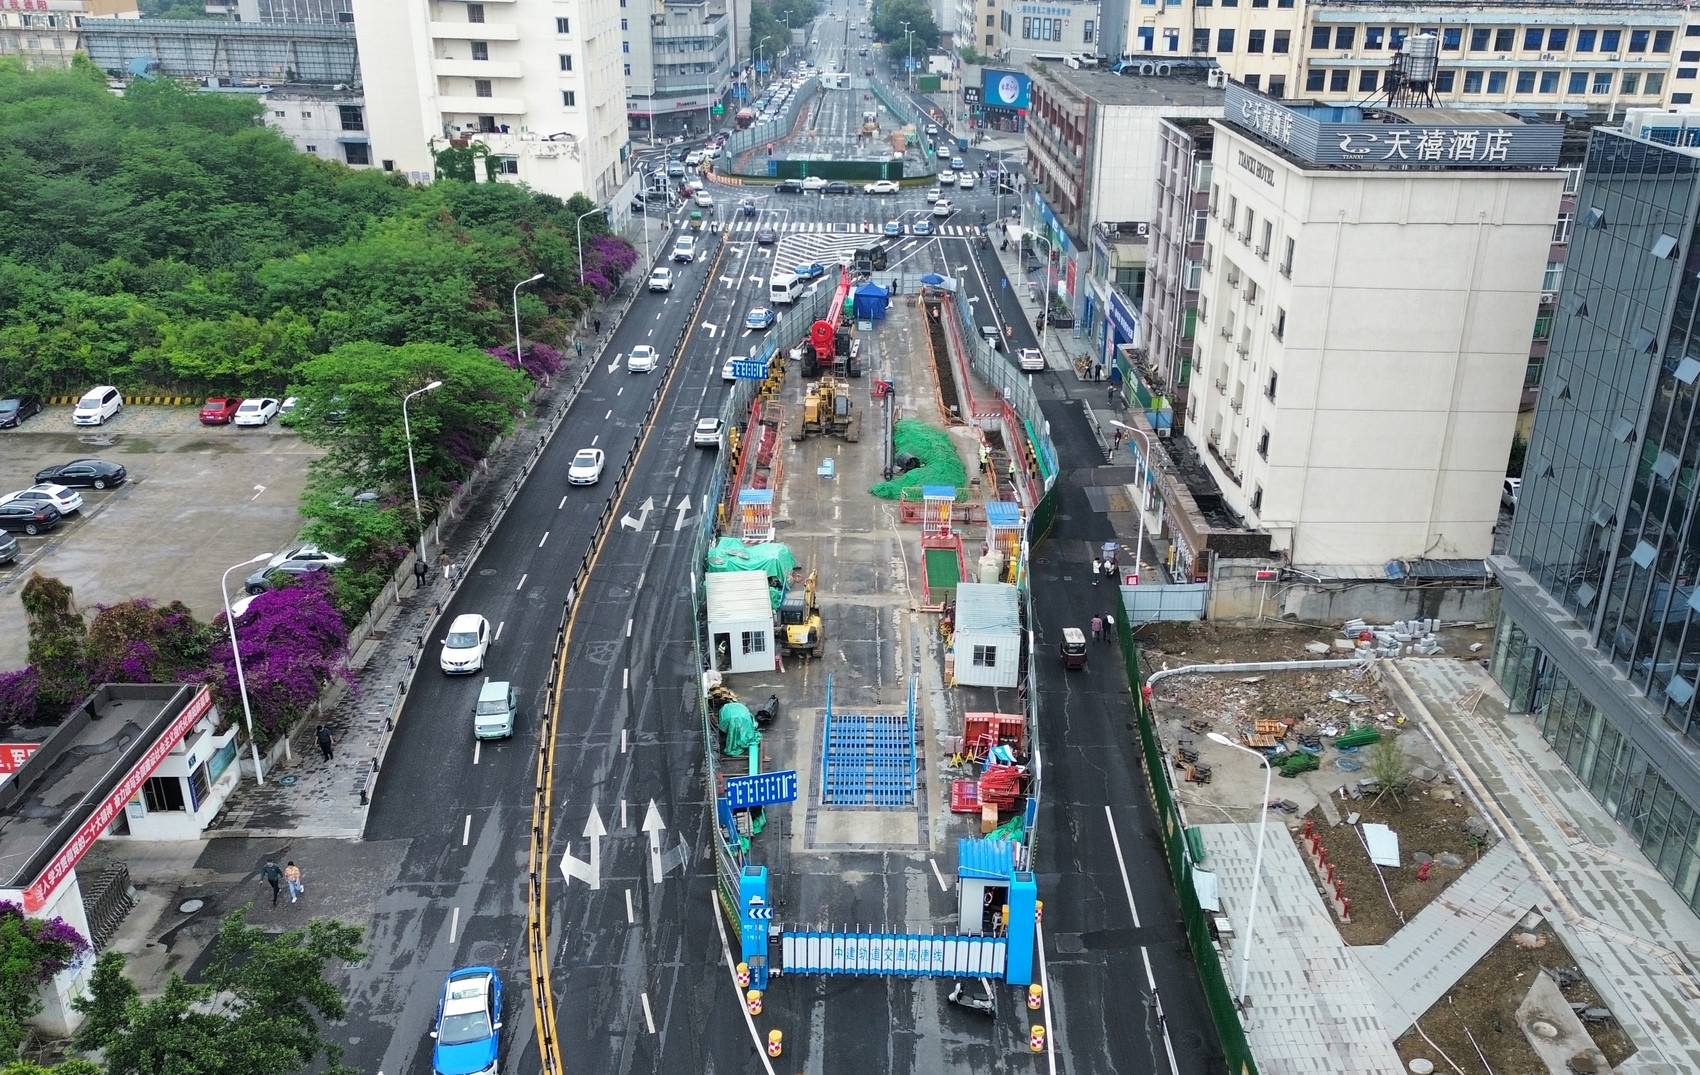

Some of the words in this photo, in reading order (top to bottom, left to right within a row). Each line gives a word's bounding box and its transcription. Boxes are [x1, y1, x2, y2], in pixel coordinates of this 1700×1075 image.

[1252, 102, 1293, 144] 天禧酒店
[1381, 129, 1513, 162] 天禧酒店
[1238, 149, 1257, 175] TIANXI
[1256, 160, 1275, 187] HOTEL
[35, 803, 114, 903] 深入学习贯彻党的二十大精神
[834, 946, 943, 962] 中建轨道交通成德线
